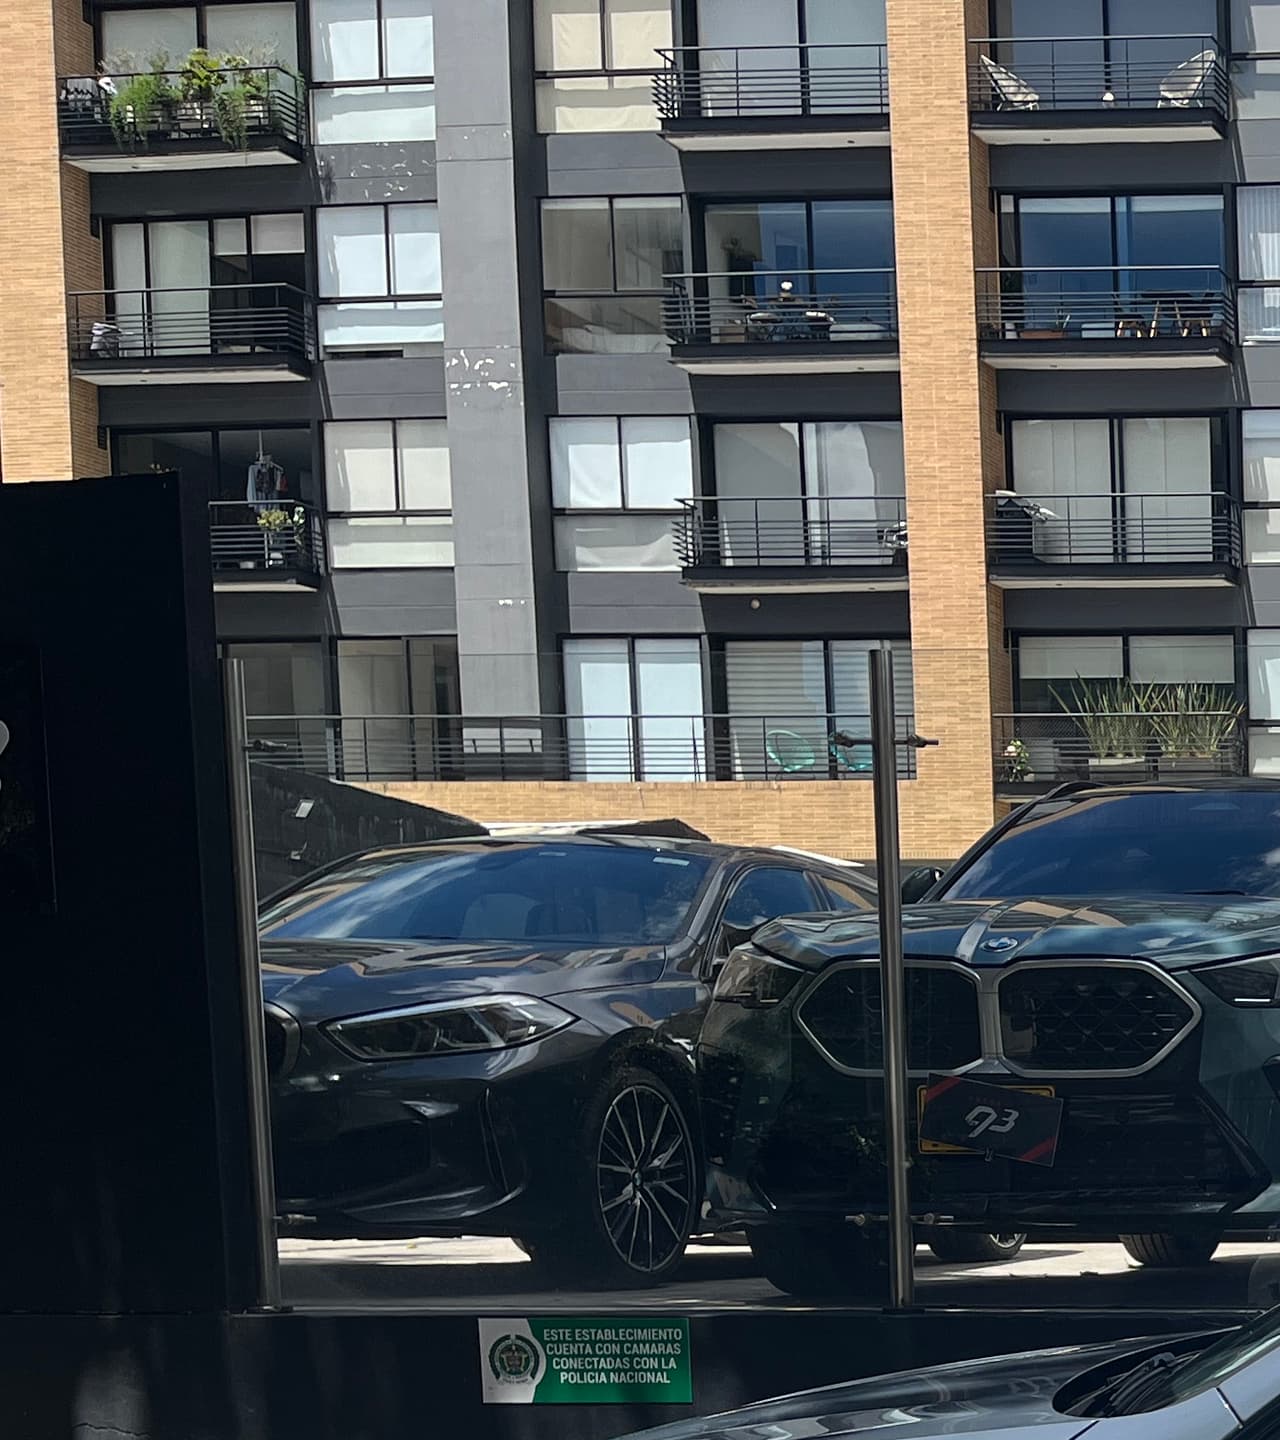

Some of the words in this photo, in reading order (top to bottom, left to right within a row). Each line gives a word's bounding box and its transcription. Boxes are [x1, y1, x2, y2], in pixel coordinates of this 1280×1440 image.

[964, 1105, 1020, 1138] 93
[543, 1328, 572, 1341] ESTE
[575, 1328, 682, 1341] ESTABLECIMIENTO
[546, 1343, 593, 1355] CUENTA
[595, 1343, 620, 1355] CON
[623, 1343, 682, 1355] CAMARAS
[552, 1357, 631, 1369] CONECTADAS
[633, 1357, 659, 1369] CON
[661, 1357, 677, 1369] LA
[560, 1371, 608, 1384] POLICIA
[610, 1371, 671, 1384] NACIONAL
